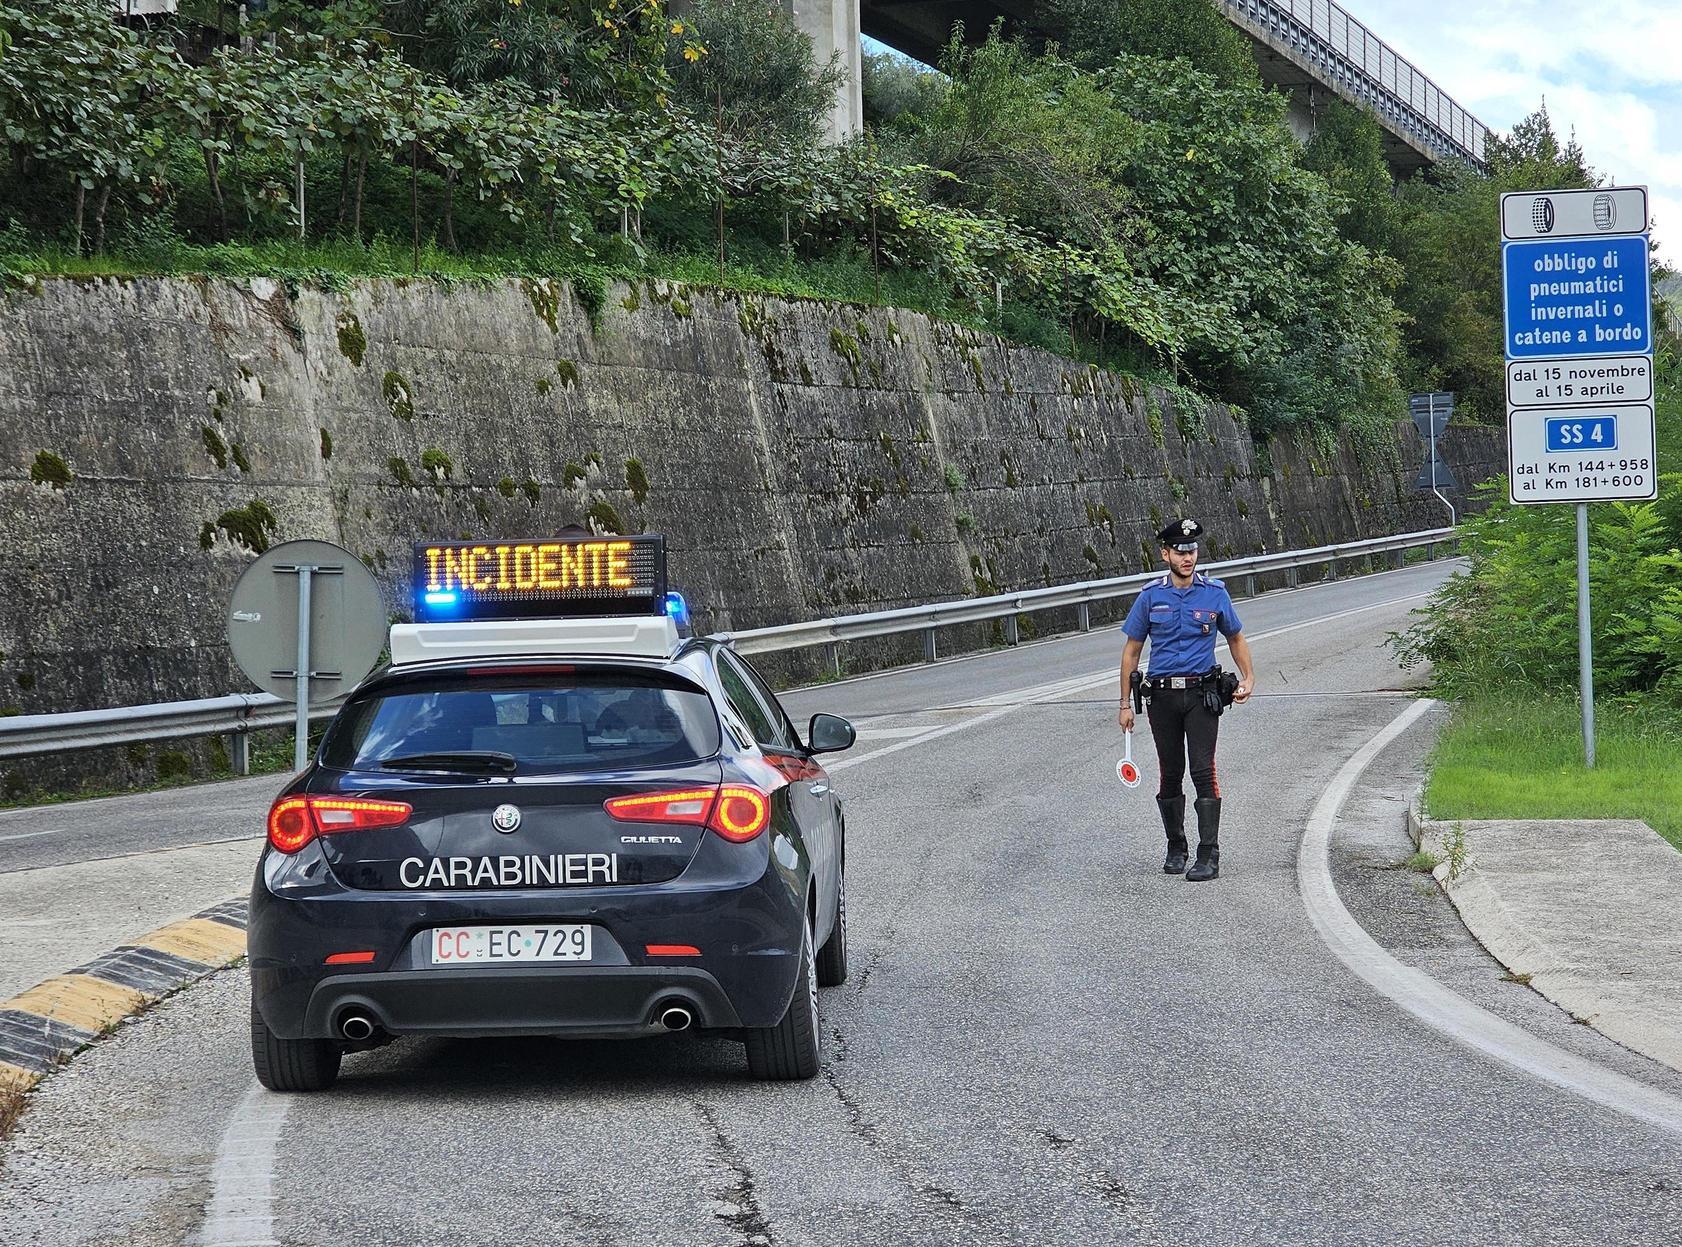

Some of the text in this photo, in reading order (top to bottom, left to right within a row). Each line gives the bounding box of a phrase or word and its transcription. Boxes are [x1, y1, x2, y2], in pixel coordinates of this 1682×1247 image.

[1534, 250, 1618, 274] obbligo di
[1530, 274, 1624, 301] pneumatici
[1531, 299, 1624, 321] invernali o
[1514, 322, 1642, 346] catene a bordo
[1513, 365, 1646, 381] dal 15 novembre
[1535, 382, 1625, 398] al 15 aprile
[1560, 423, 1604, 444] SS 4
[1516, 458, 1649, 475] dal Km 144+958
[1523, 474, 1644, 491] al Km 181+600
[425, 543, 632, 592] INCIDENTE
[620, 835, 683, 844] GIULIETTA
[399, 852, 619, 888] CARABINIERI
[438, 929, 585, 959] CC EC 729
